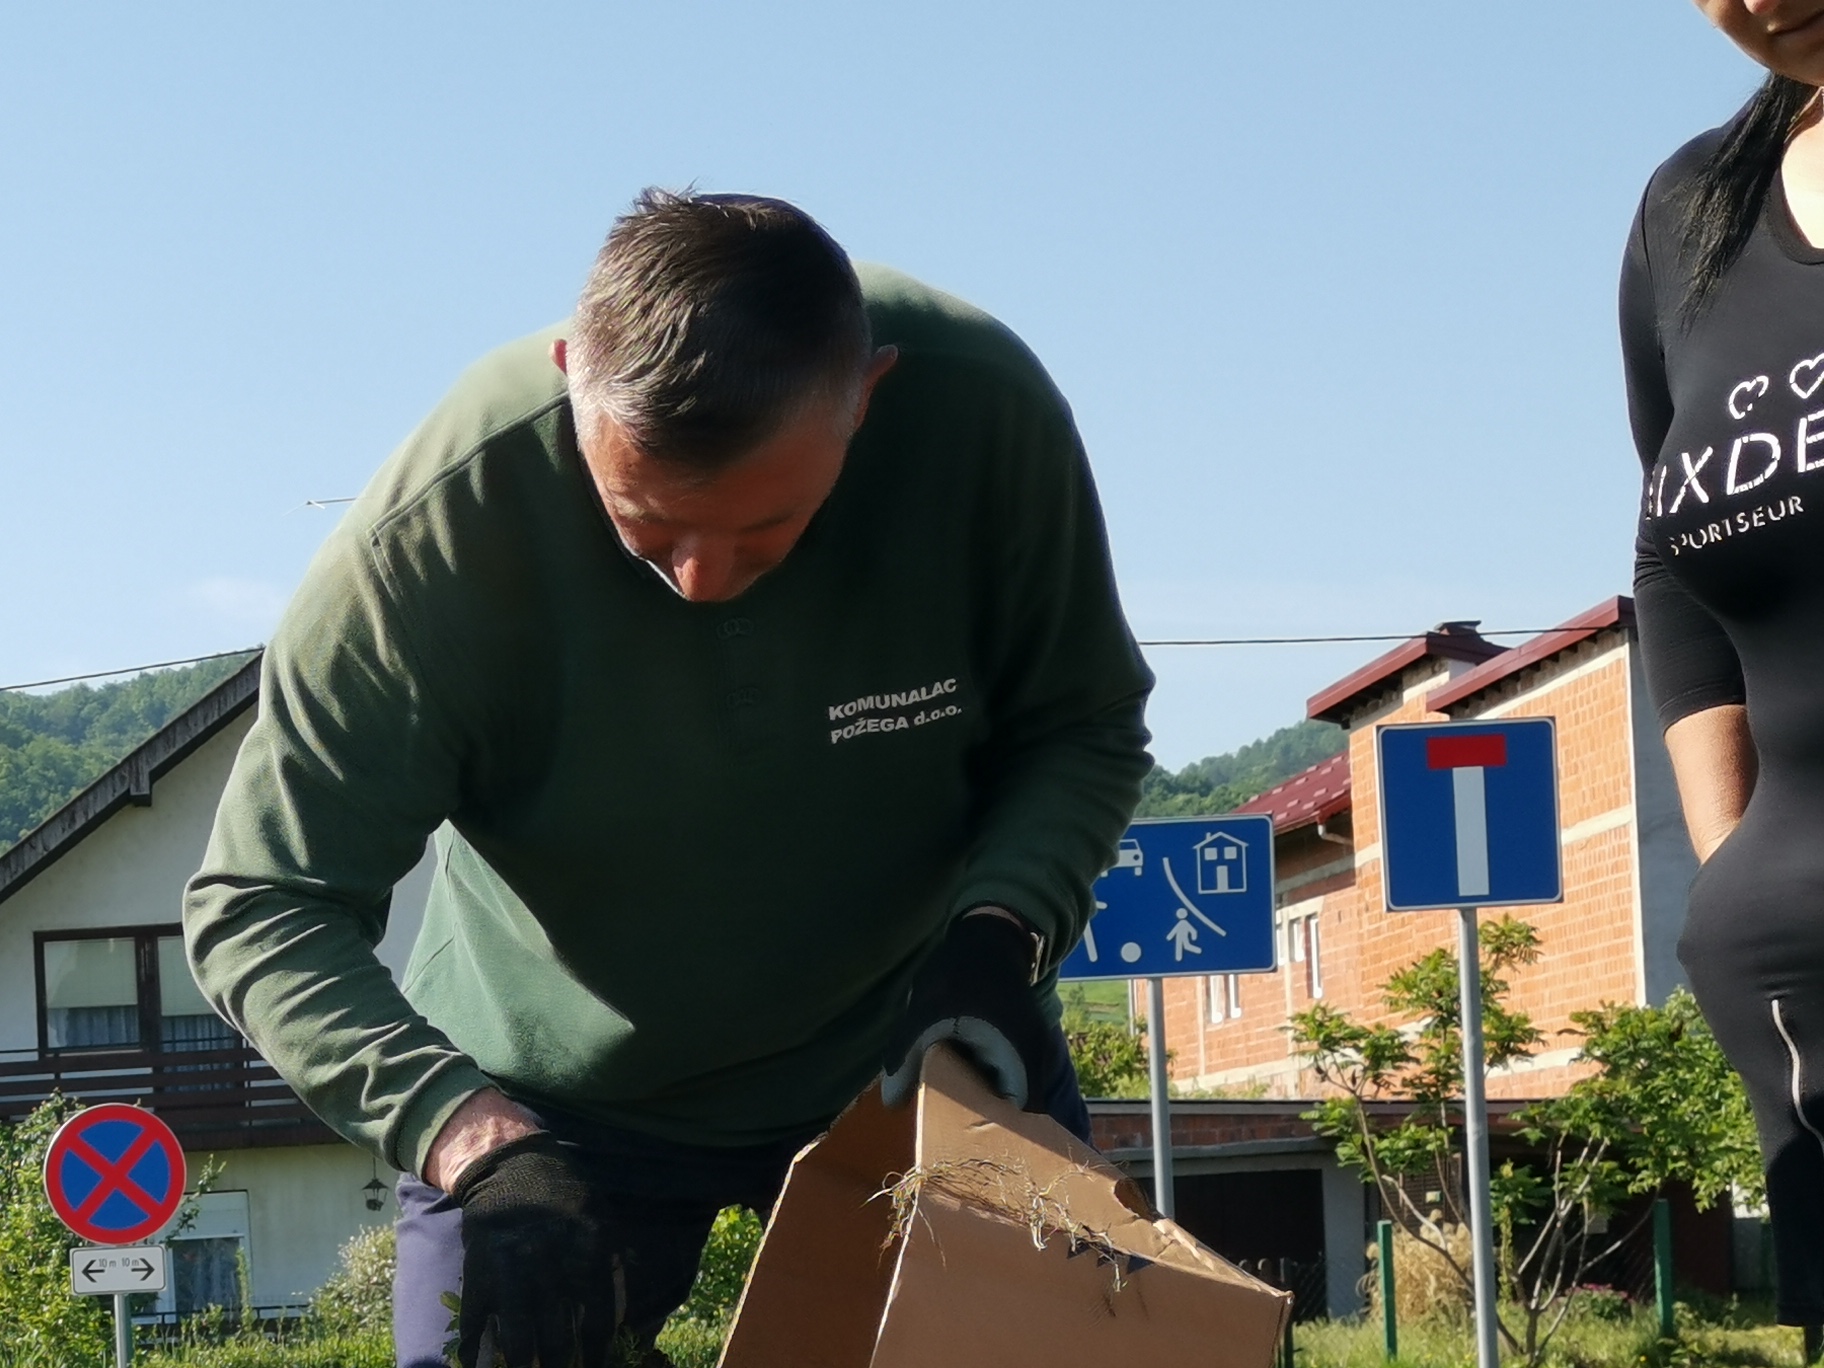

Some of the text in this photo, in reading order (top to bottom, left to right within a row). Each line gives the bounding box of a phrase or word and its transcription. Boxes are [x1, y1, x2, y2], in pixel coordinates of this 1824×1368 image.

[1645, 408, 1824, 521] IXDE
[828, 678, 958, 721] KOMUNALAC
[830, 705, 963, 745] POŽEGA d.o.o.
[98, 1257, 140, 1268] 10 m 10 m
